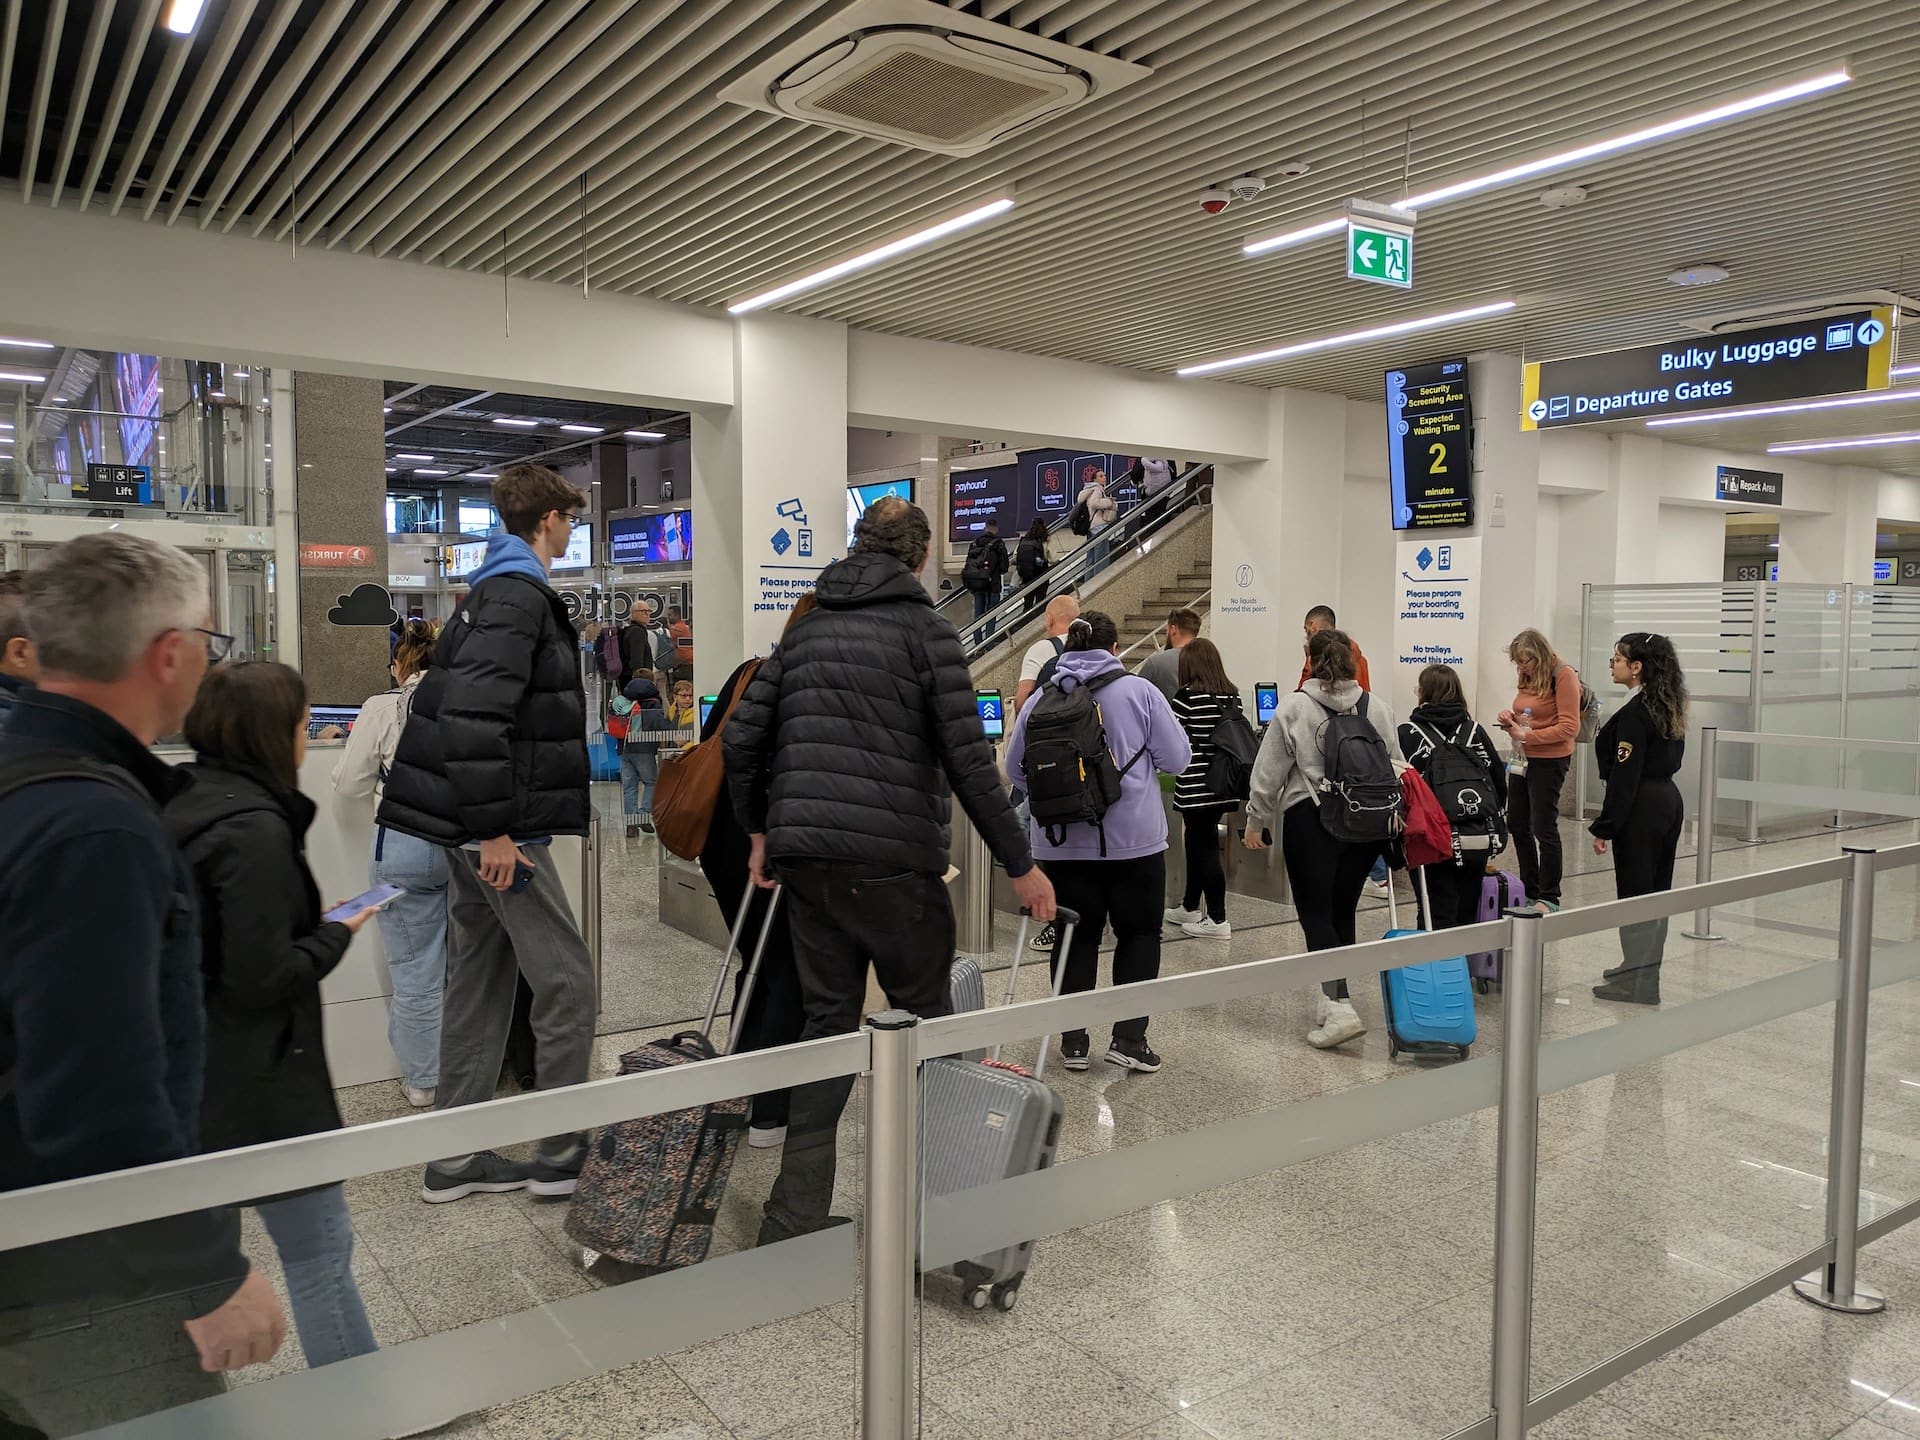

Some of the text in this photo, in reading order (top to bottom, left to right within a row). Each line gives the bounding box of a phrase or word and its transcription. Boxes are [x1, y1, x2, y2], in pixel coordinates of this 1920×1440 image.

[1660, 336, 1816, 370] Bulky Luggage
[1420, 384, 1450, 396] Security
[1408, 394, 1463, 407] Screening Area
[1576, 380, 1733, 414] Departure Gates
[1420, 413, 1454, 425] Expected
[1413, 424, 1460, 436] Waiting Time
[1429, 443, 1447, 474] 2
[116, 486, 133, 496] Lift
[954, 480, 988, 494] payhound
[1740, 480, 1776, 493] Repack Area
[1425, 488, 1454, 496] minutes
[1740, 568, 1758, 580] 33
[1874, 571, 1891, 579] ROP
[760, 577, 817, 588] Please prepa
[762, 591, 782, 599] your
[1432, 590, 1462, 599] prepare
[754, 603, 774, 612] pass
[1222, 605, 1240, 613] beyond
[1408, 600, 1459, 610] your boarding
[1430, 612, 1464, 620] scanning
[1425, 645, 1451, 655] trolleys
[1400, 656, 1427, 664] beyond
